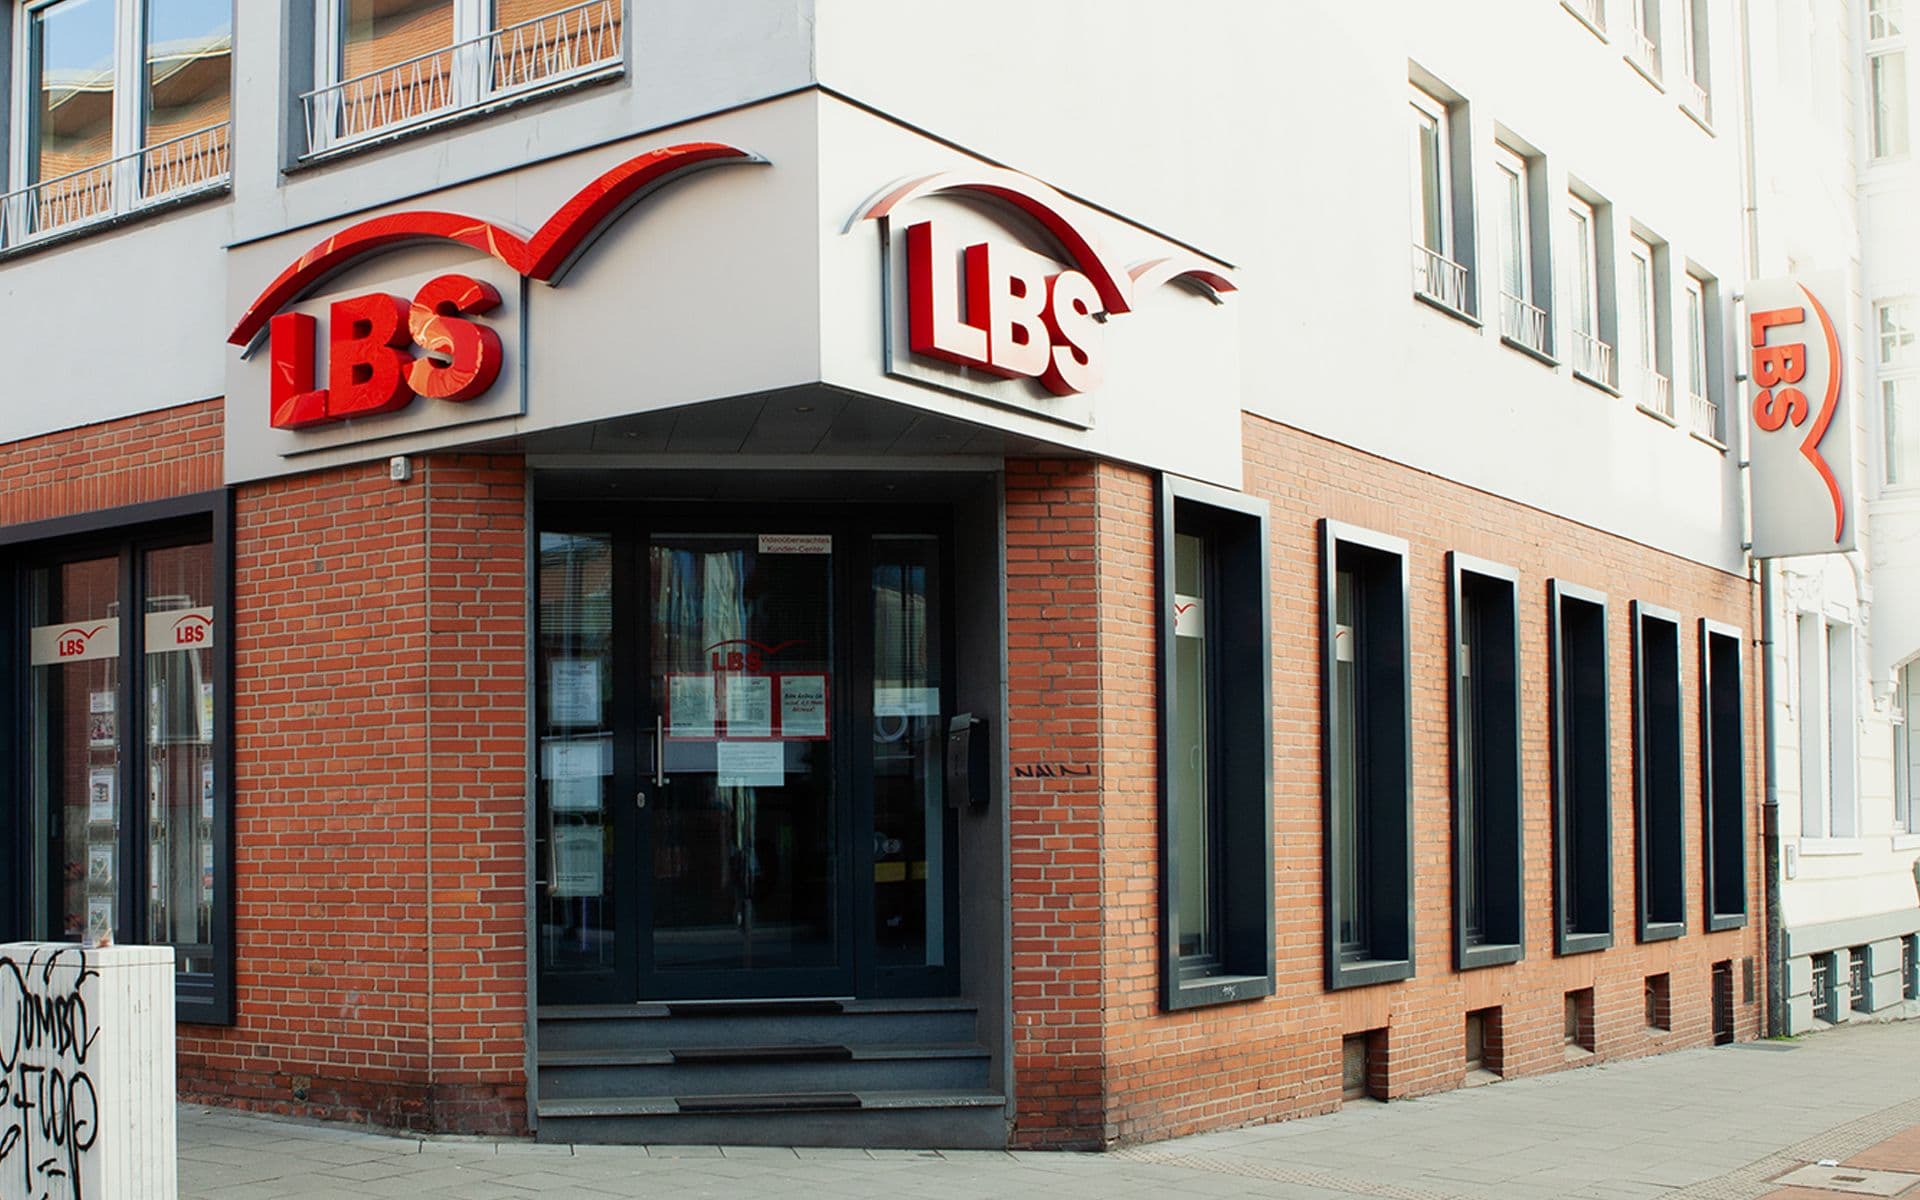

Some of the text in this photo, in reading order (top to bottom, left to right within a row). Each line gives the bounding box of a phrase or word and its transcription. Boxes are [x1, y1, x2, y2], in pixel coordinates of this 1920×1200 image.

[907, 221, 1104, 396] LBS
[270, 273, 504, 430] LBS
[1750, 306, 1808, 432] LBS
[59, 638, 85, 656] LBS
[176, 625, 204, 644] LBS
[711, 651, 763, 672] LBS
